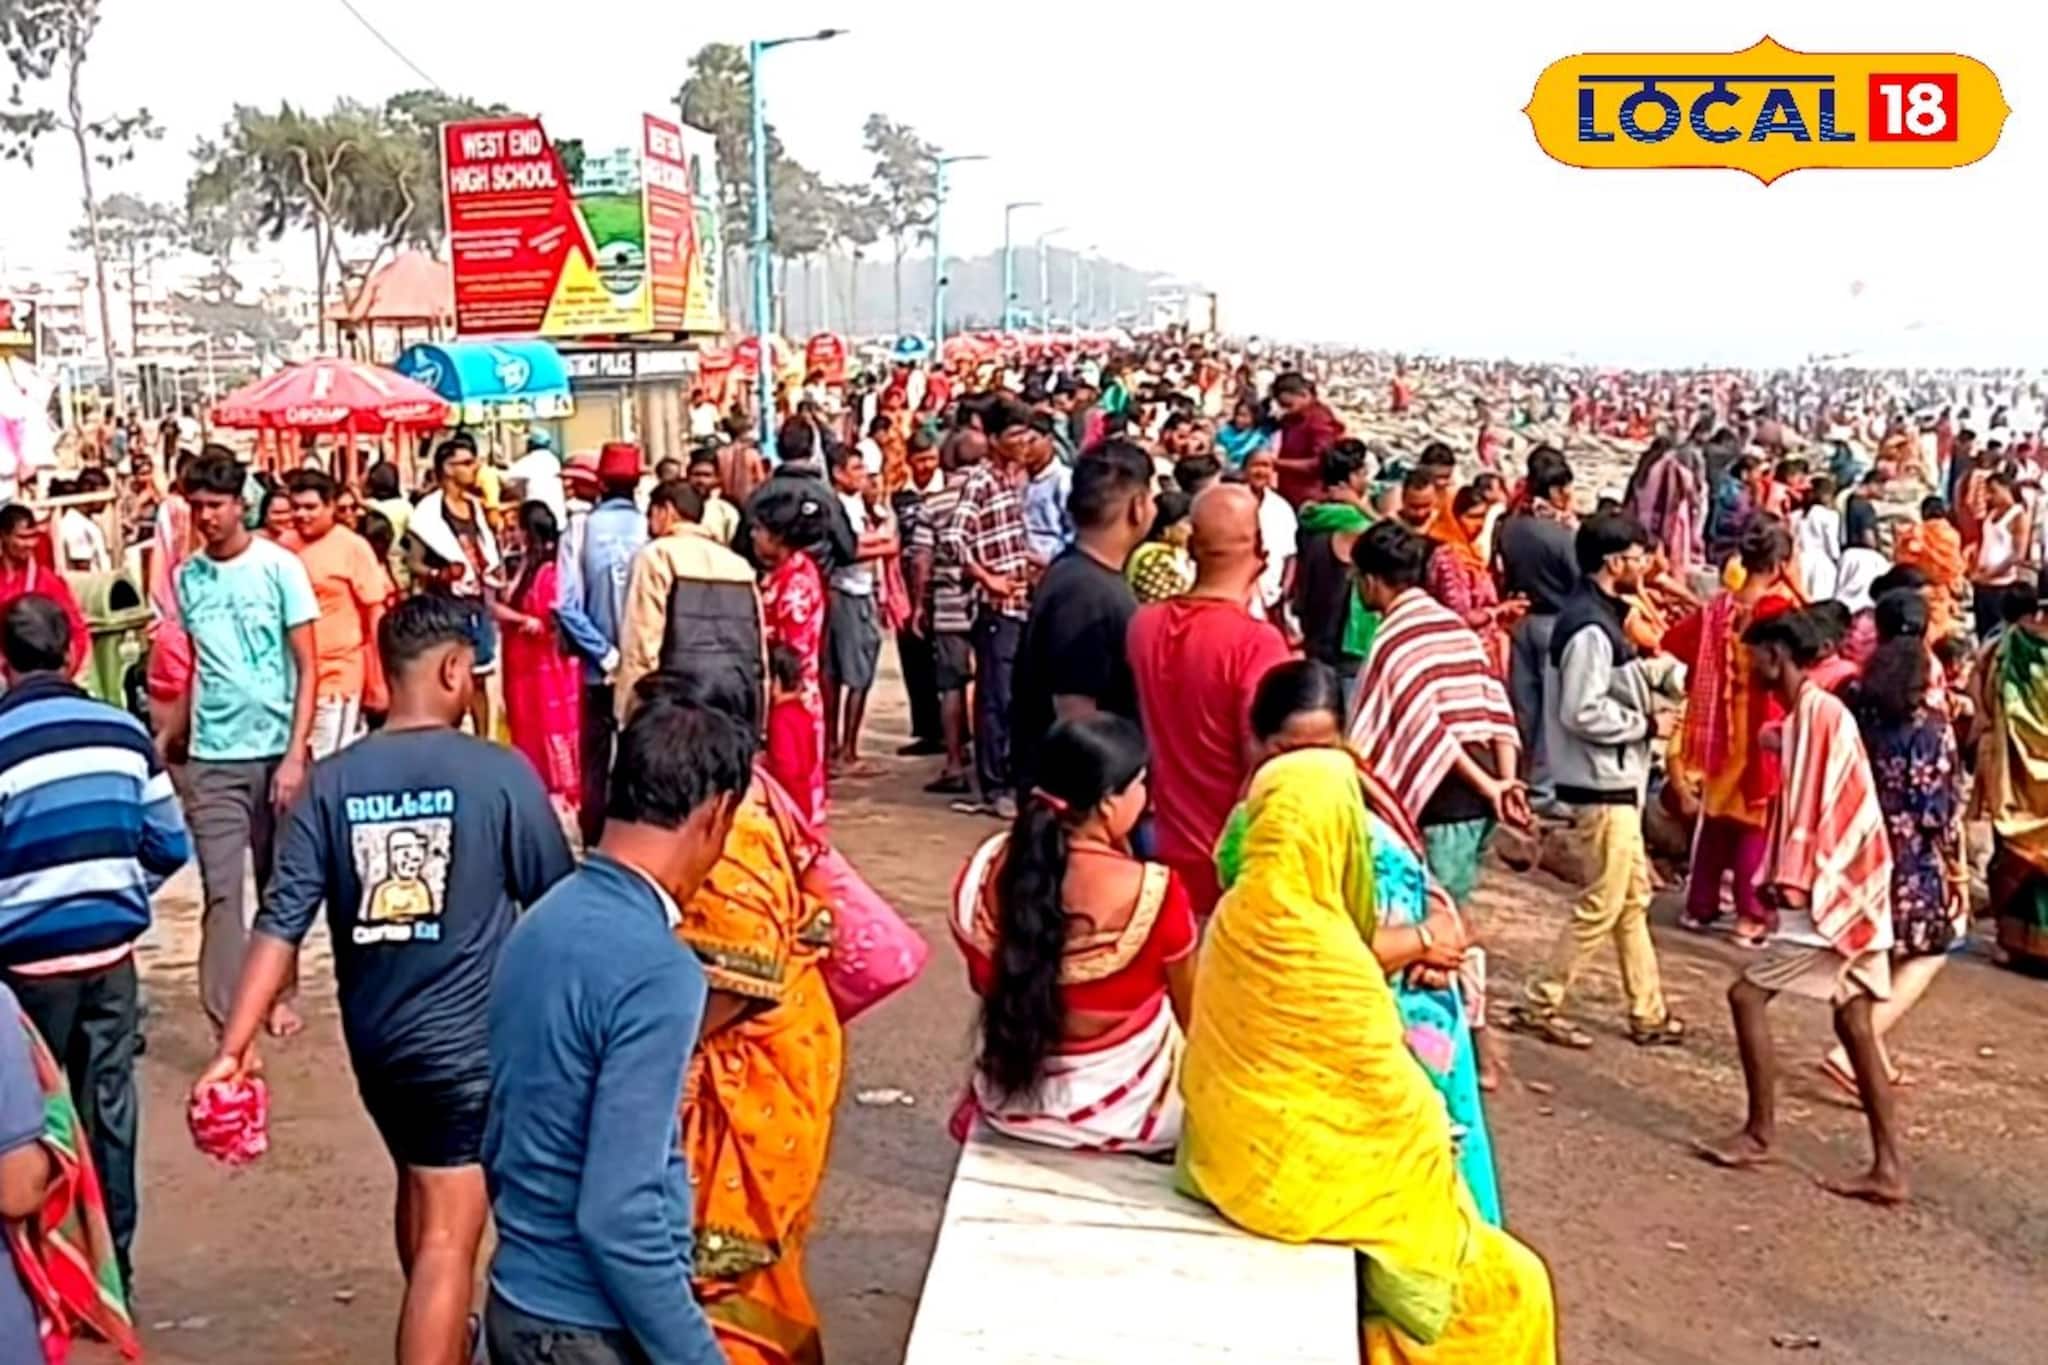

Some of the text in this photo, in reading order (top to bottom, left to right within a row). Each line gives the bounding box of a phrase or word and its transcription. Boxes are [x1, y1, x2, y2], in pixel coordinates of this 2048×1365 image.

[461, 129, 542, 159] WEST END
[450, 161, 557, 193] HIGH SCHOOL
